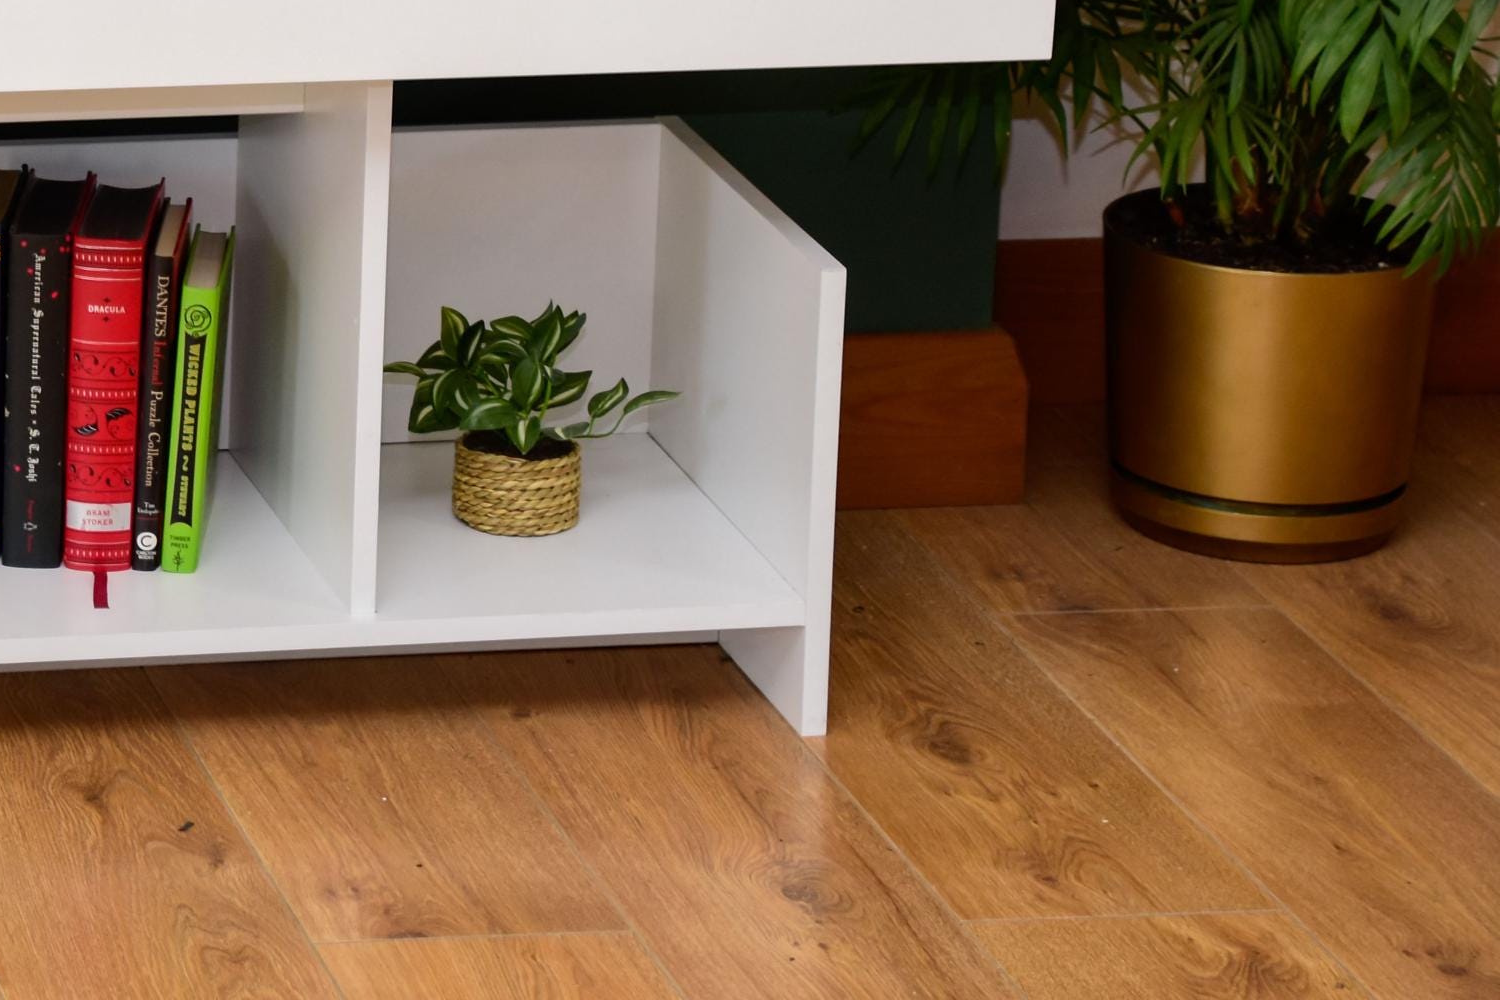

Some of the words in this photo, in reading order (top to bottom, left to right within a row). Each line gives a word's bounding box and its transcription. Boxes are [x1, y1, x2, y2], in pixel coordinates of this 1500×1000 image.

[33, 252, 46, 304] American
[87, 304, 126, 314] DRACULA
[30, 307, 44, 380] Supernatural
[185, 343, 201, 396] WICKED
[29, 385, 42, 415] Tales
[148, 390, 164, 428] Puzzle
[181, 399, 197, 452] PLANTS
[25, 457, 40, 483] Joshi
[144, 432, 161, 487] Collection
